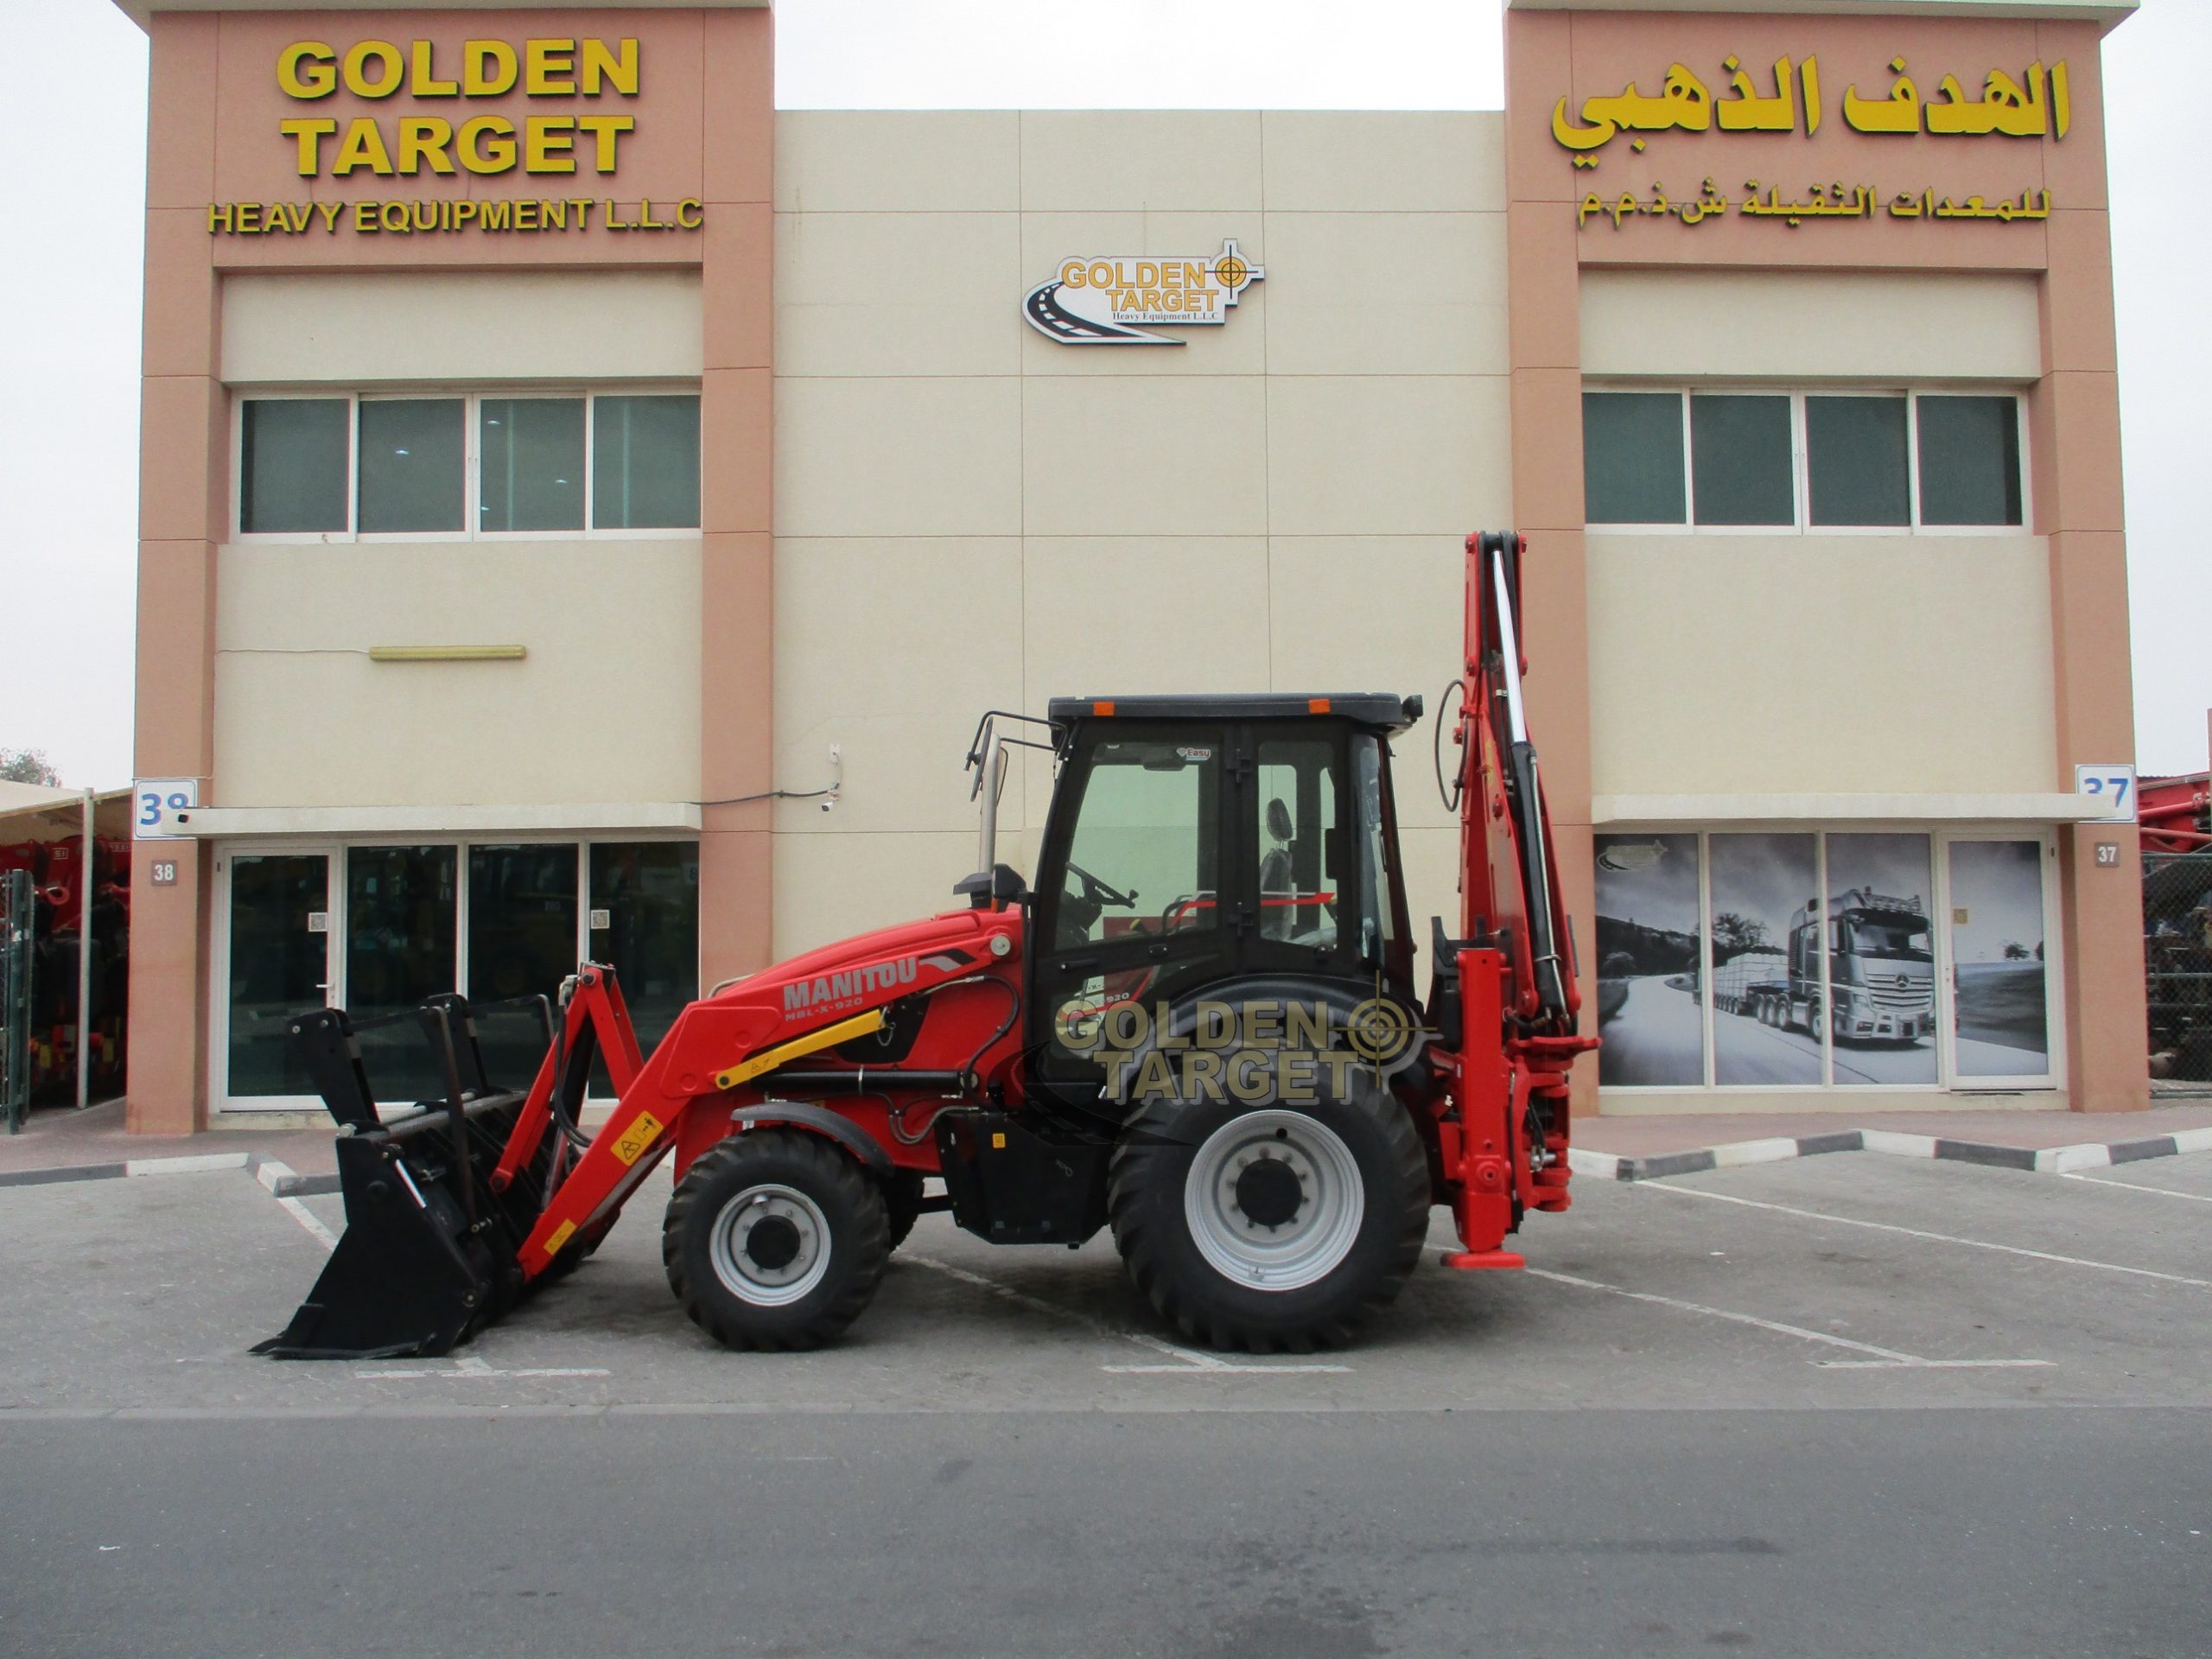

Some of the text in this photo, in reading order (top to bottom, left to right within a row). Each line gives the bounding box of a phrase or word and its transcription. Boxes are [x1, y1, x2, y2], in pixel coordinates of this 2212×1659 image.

[276, 38, 641, 99] GOLDEN
[1552, 54, 2072, 168] الهدف الذهبي
[278, 115, 636, 177] TARGET
[207, 197, 706, 235] HEAVY EQUIPMENT L.L.C
[1740, 179, 1878, 227] الثقيلة
[1889, 185, 2053, 222] للمعدات
[1061, 262, 1205, 289] GOLDEN
[1105, 289, 1219, 312] TARGET
[1113, 312, 1218, 321] Heavy Equipment L.L.C
[154, 863, 175, 881] 38
[2098, 846, 2117, 862] 37
[783, 956, 918, 1011] MANITOU
